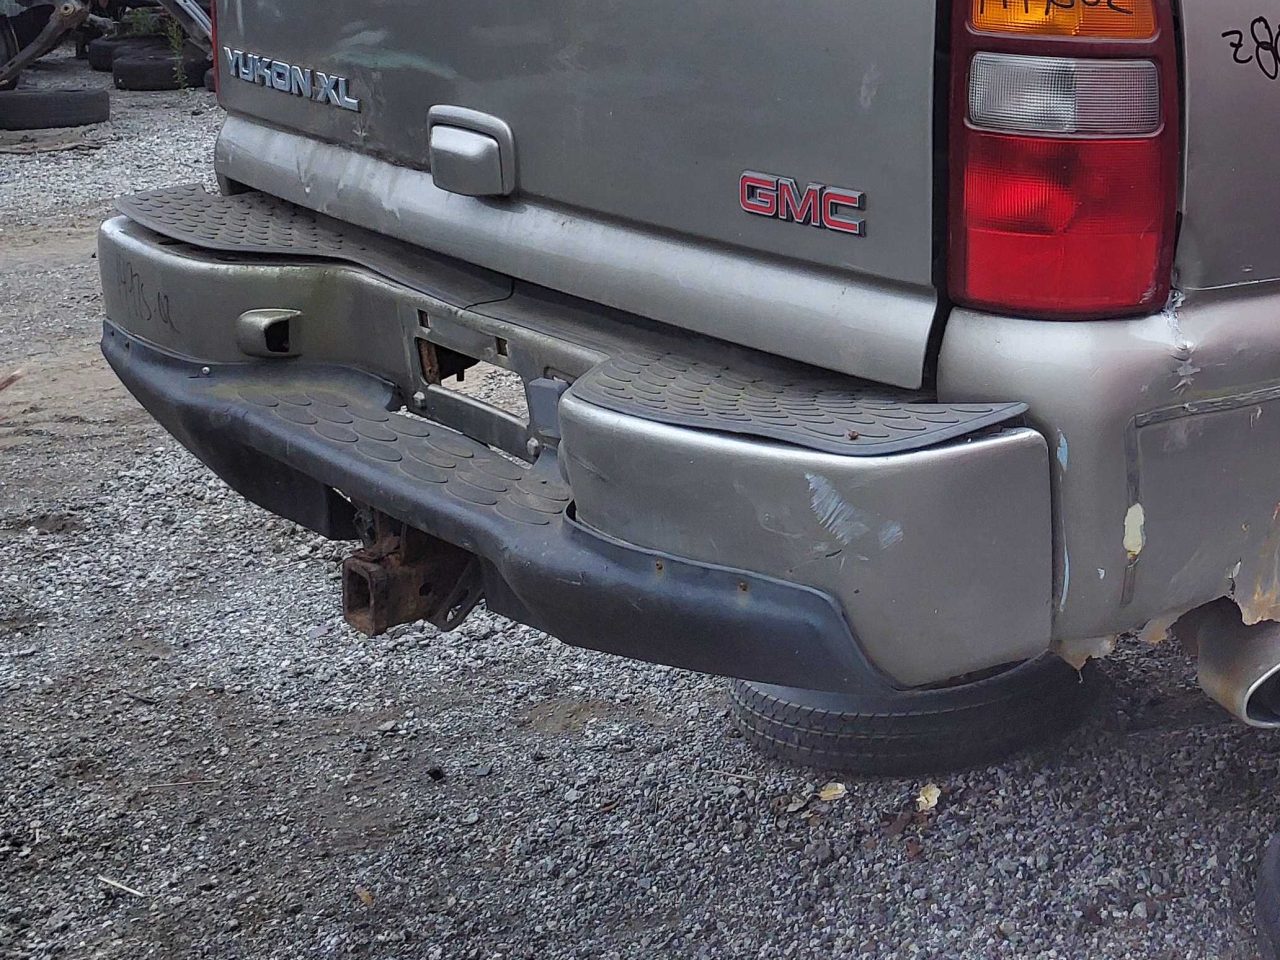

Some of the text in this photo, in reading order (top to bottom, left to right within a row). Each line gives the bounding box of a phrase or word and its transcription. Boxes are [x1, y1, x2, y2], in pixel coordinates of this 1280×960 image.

[223, 46, 361, 113] YUKON XL
[739, 169, 866, 237] GMC
